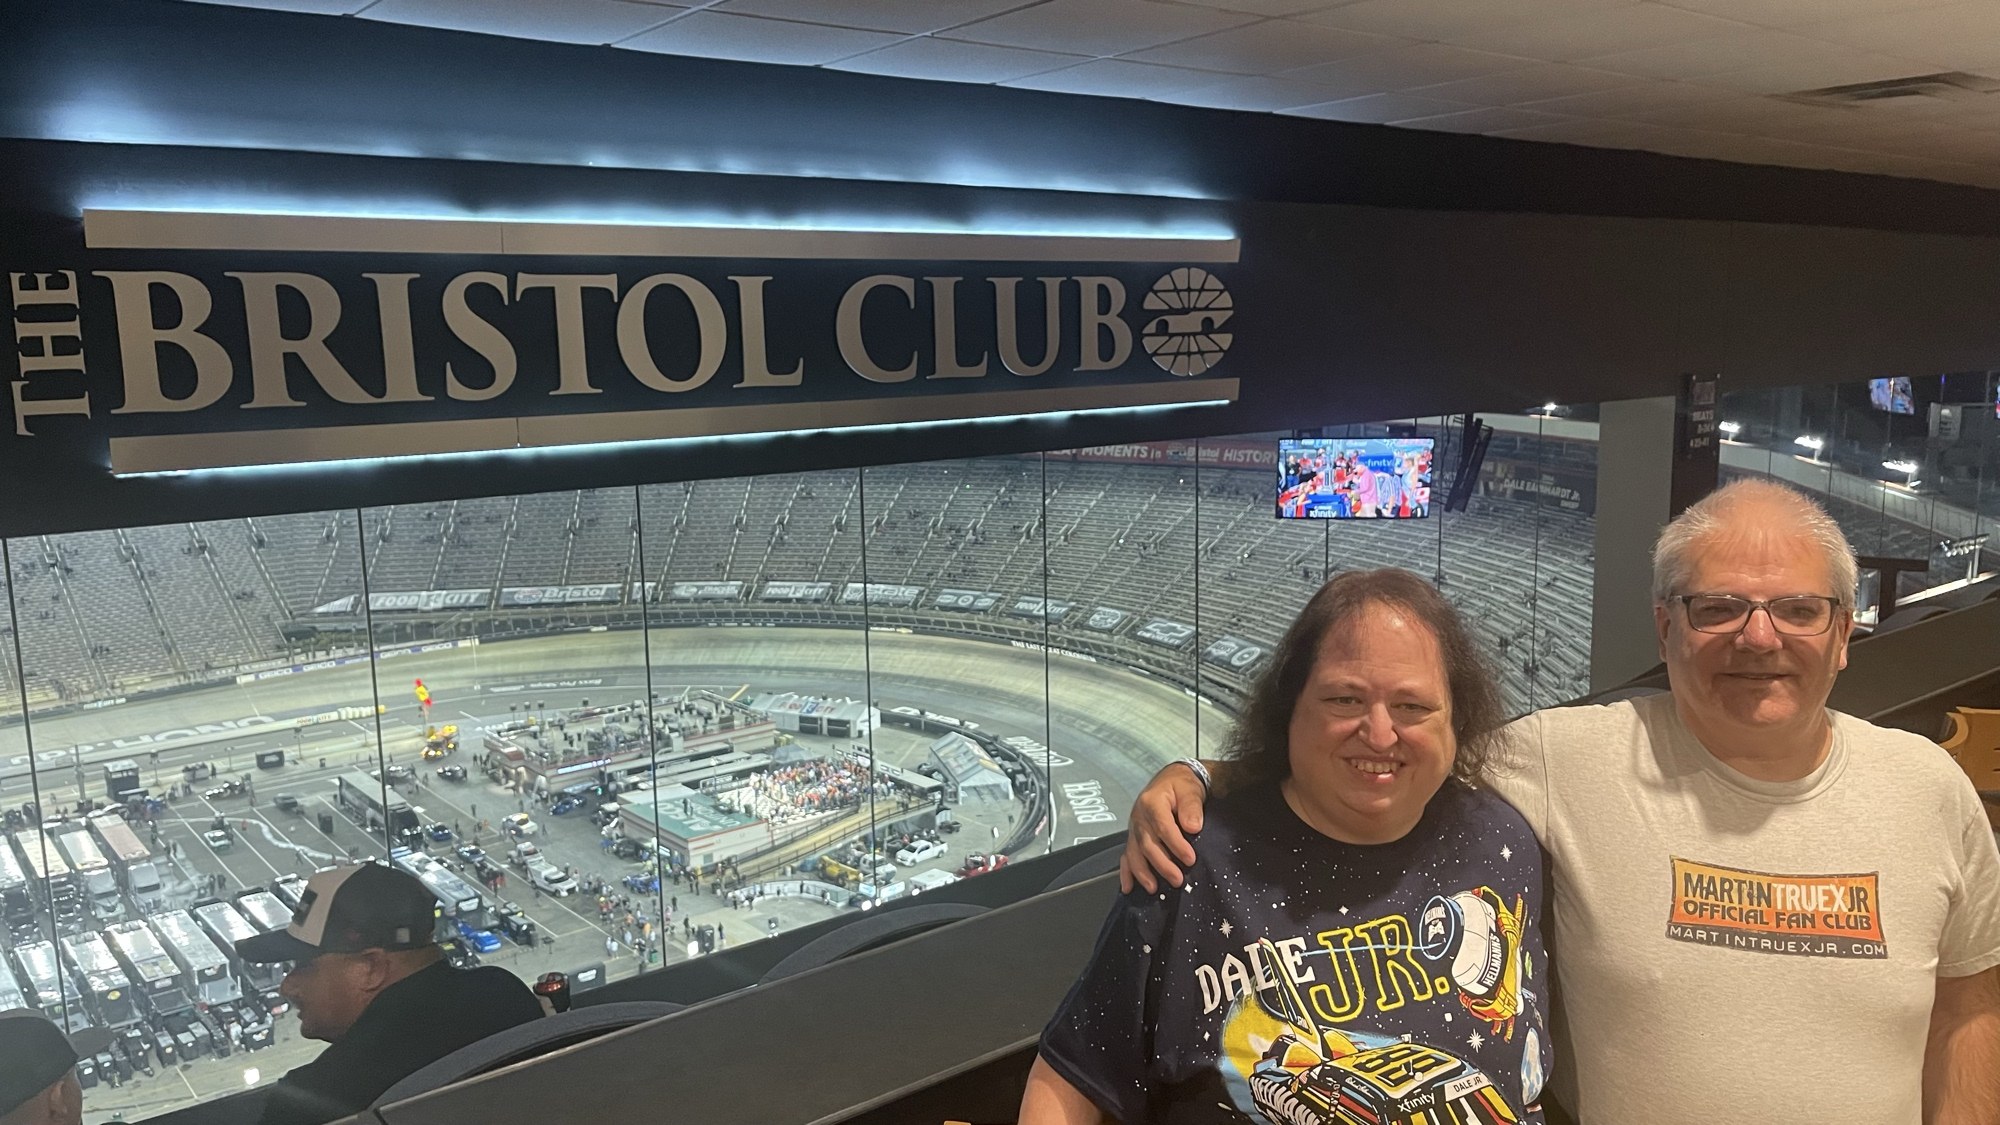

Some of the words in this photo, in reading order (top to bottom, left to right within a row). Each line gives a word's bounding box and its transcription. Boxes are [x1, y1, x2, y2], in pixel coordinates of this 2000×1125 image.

[10, 269, 92, 437] THE
[92, 269, 804, 414] BRISTOL
[835, 274, 1133, 384] CLUB
[376, 595, 418, 606] FOOD
[444, 591, 480, 604] CITY
[541, 586, 608, 602] Bristol
[1682, 899, 1770, 927] OFFICIAL
[1775, 911, 1816, 930] FAN
[1822, 912, 1872, 931] CLUB
[1195, 936, 1316, 1015] DALE
[1309, 914, 1449, 1023] JR.
[1453, 1080, 1473, 1093] DALE
[1473, 1077, 1483, 1088] JR
[1397, 1091, 1436, 1114] xfinity
